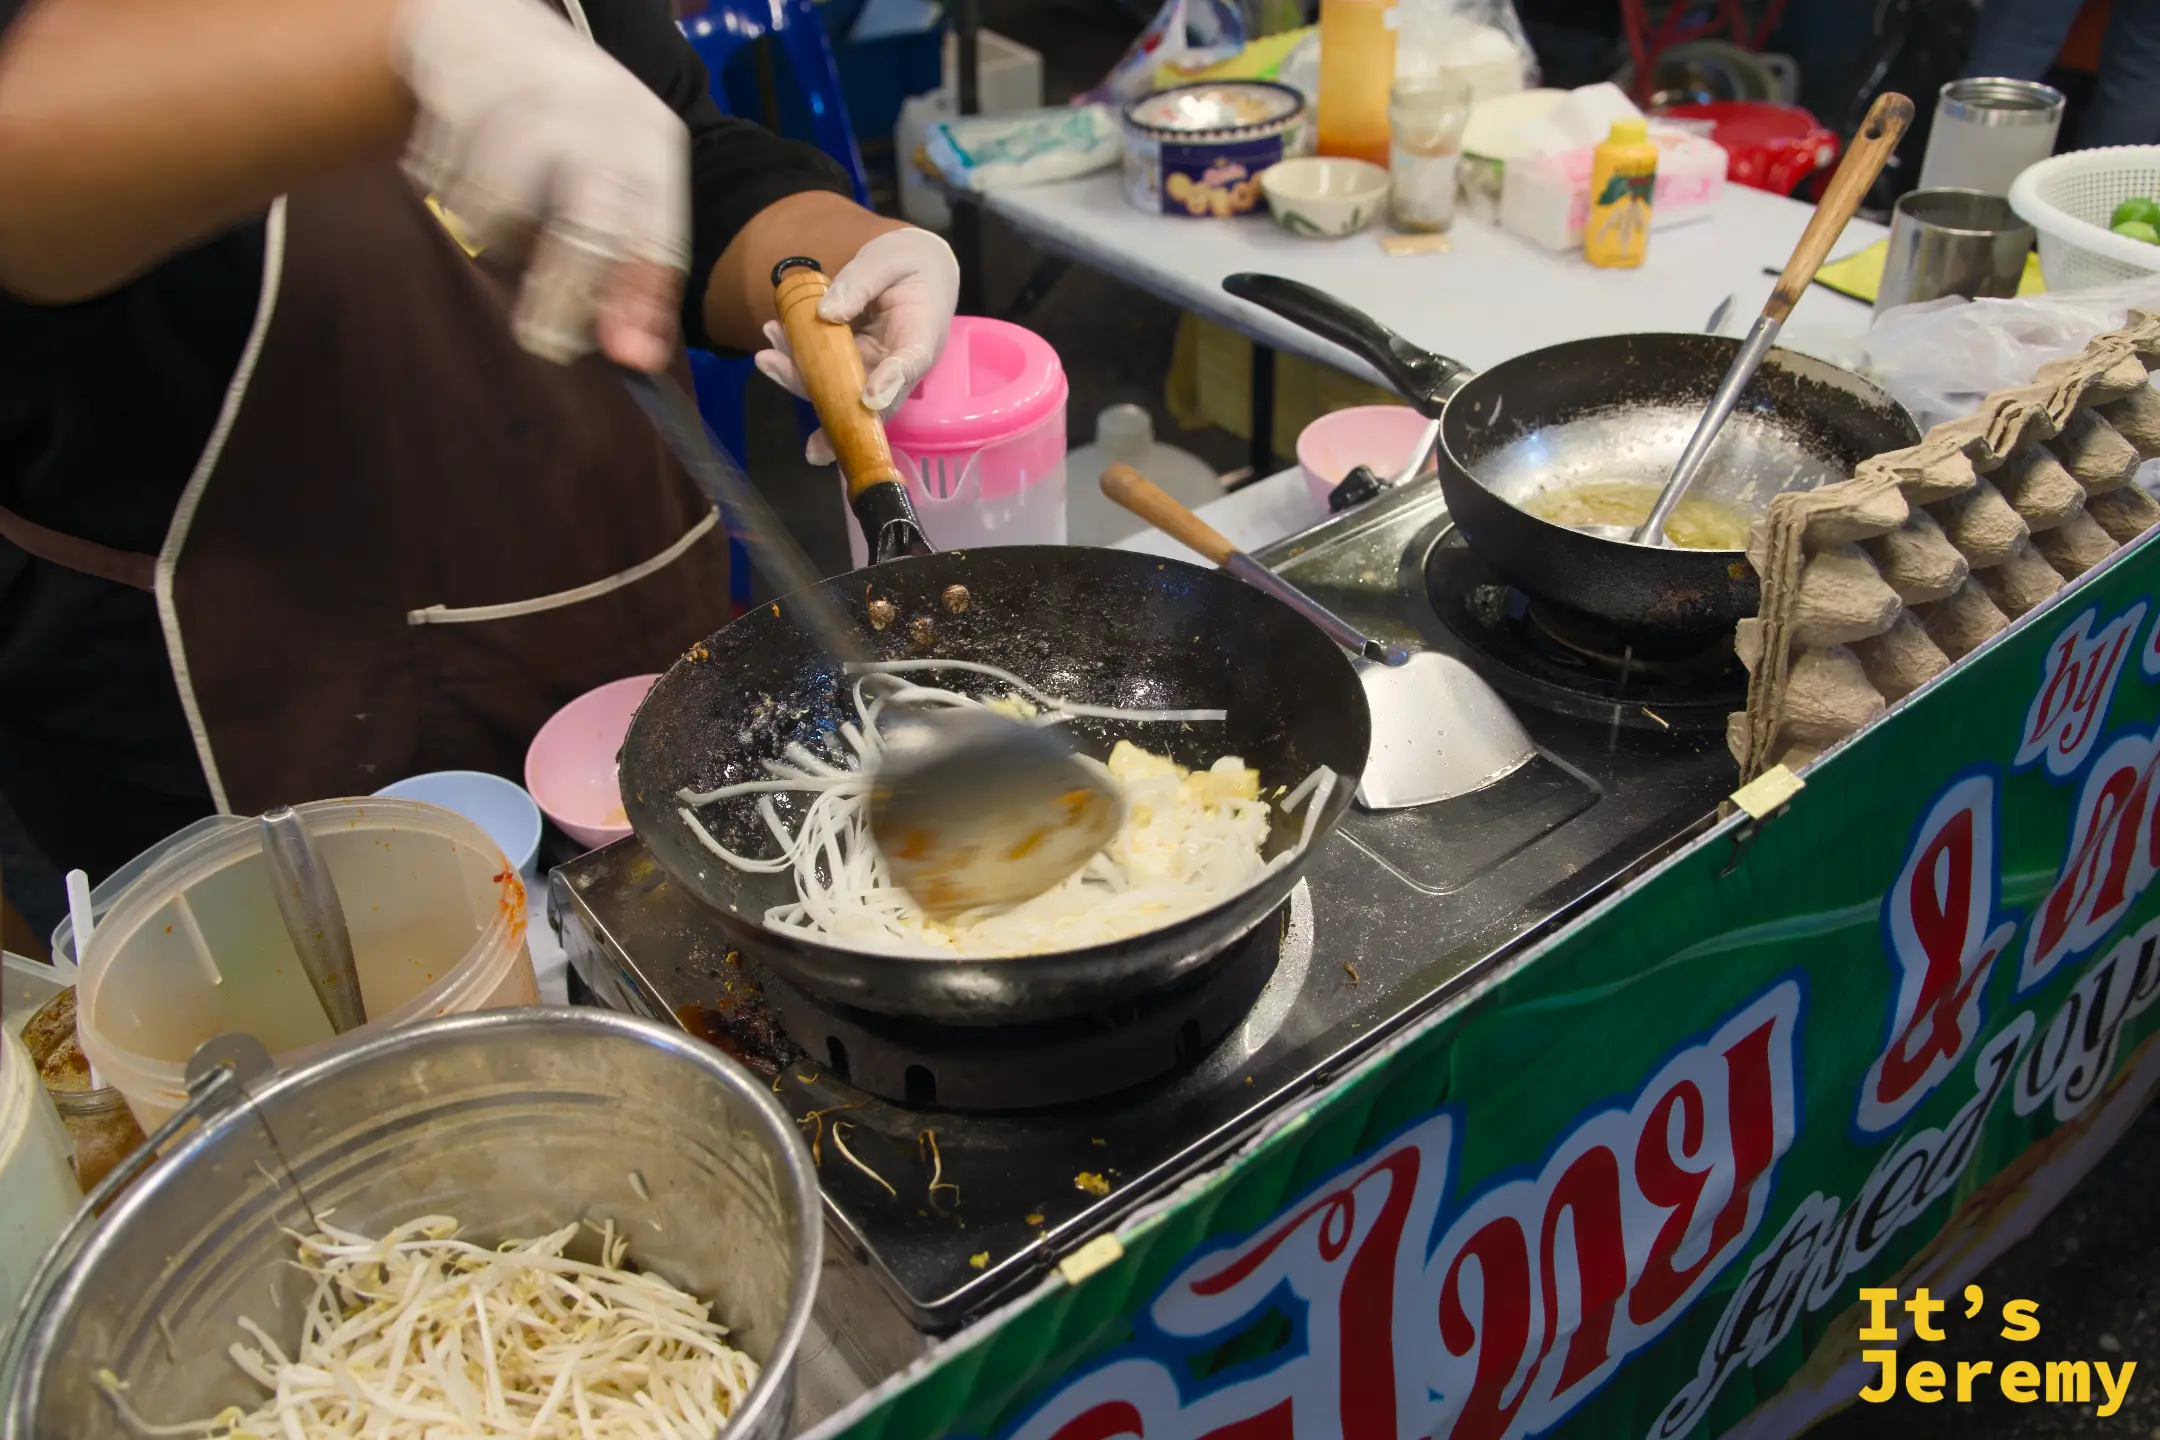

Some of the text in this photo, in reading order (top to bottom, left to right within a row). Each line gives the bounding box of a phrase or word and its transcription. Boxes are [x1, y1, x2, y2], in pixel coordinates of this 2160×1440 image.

[2027, 622, 2133, 755] by
[1046, 1016, 1778, 1440] ไทย
[1876, 806, 1996, 1104] &
